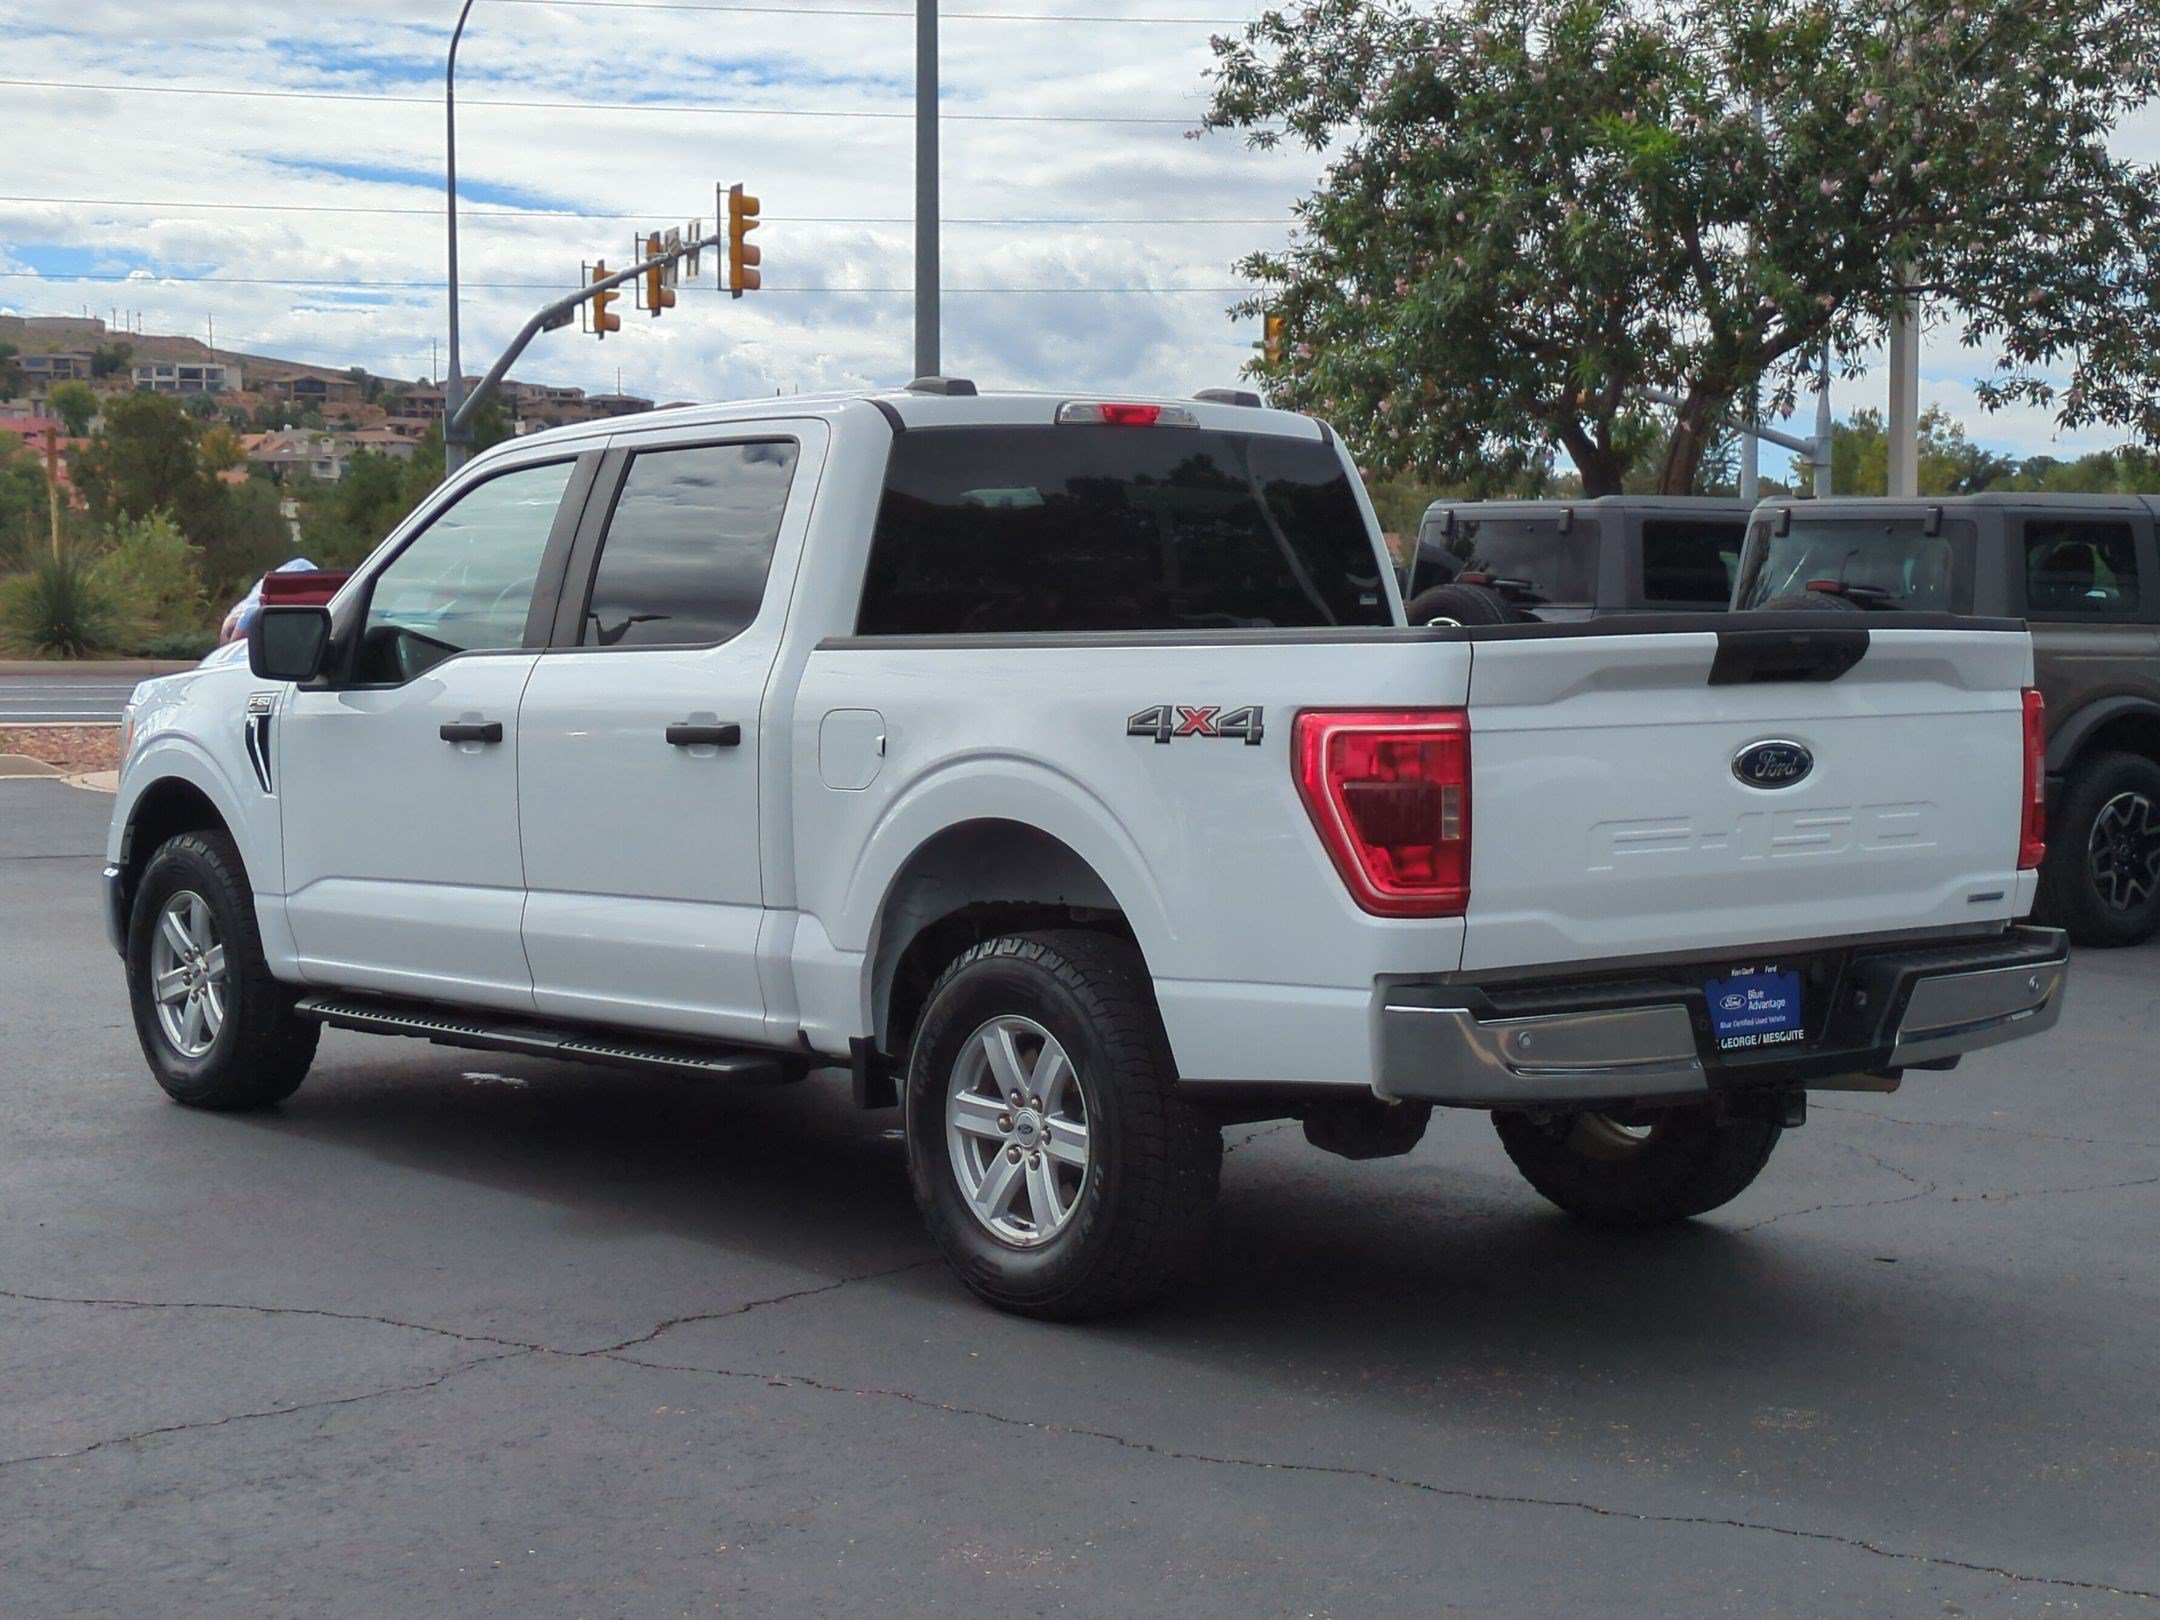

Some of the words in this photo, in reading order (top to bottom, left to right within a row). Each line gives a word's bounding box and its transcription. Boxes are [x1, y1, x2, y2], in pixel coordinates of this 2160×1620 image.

[1755, 750, 1798, 777] Ford
[1587, 801, 1938, 872] F-150
[1748, 989, 1764, 999] Blue
[1724, 995, 1742, 1008] Ford
[1748, 999, 1785, 1010] Advantage
[1721, 1034, 1757, 1049] GEORGE
